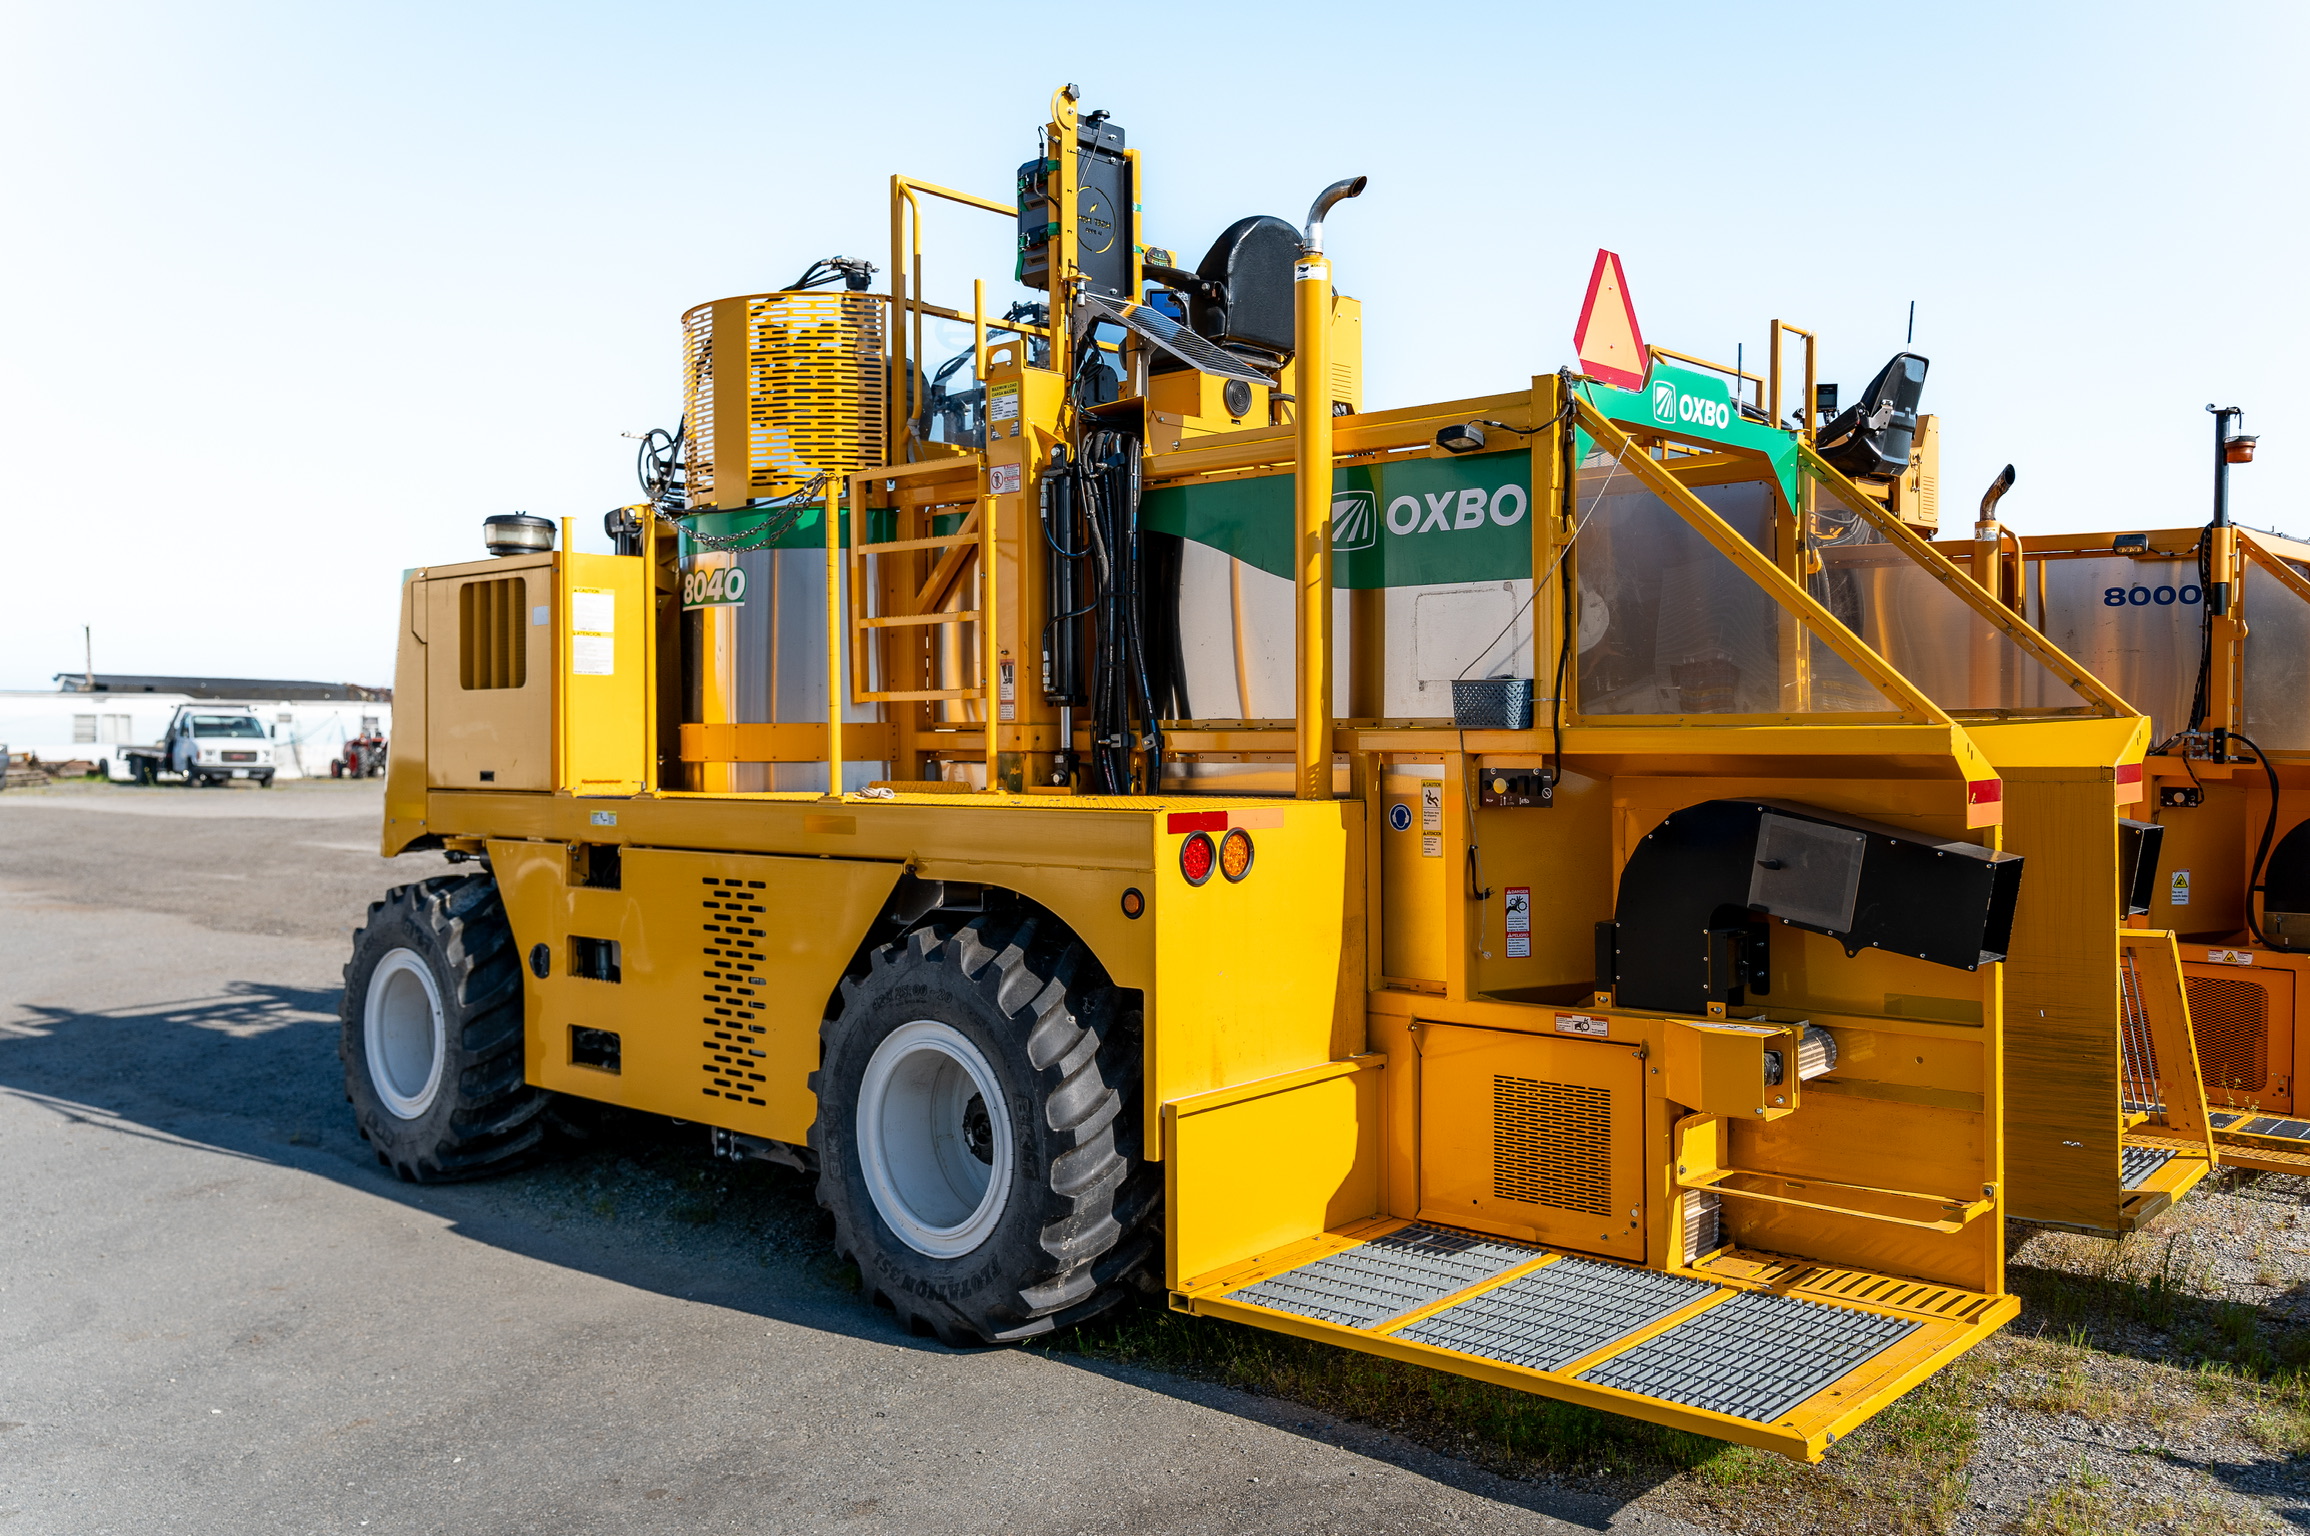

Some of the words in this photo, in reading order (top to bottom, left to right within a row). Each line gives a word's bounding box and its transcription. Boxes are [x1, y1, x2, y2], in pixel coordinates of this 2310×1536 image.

[1679, 394, 1729, 430] OXBO
[1386, 484, 1527, 536] OXBO
[683, 567, 747, 605] 8040
[2103, 585, 2203, 607] 8000
